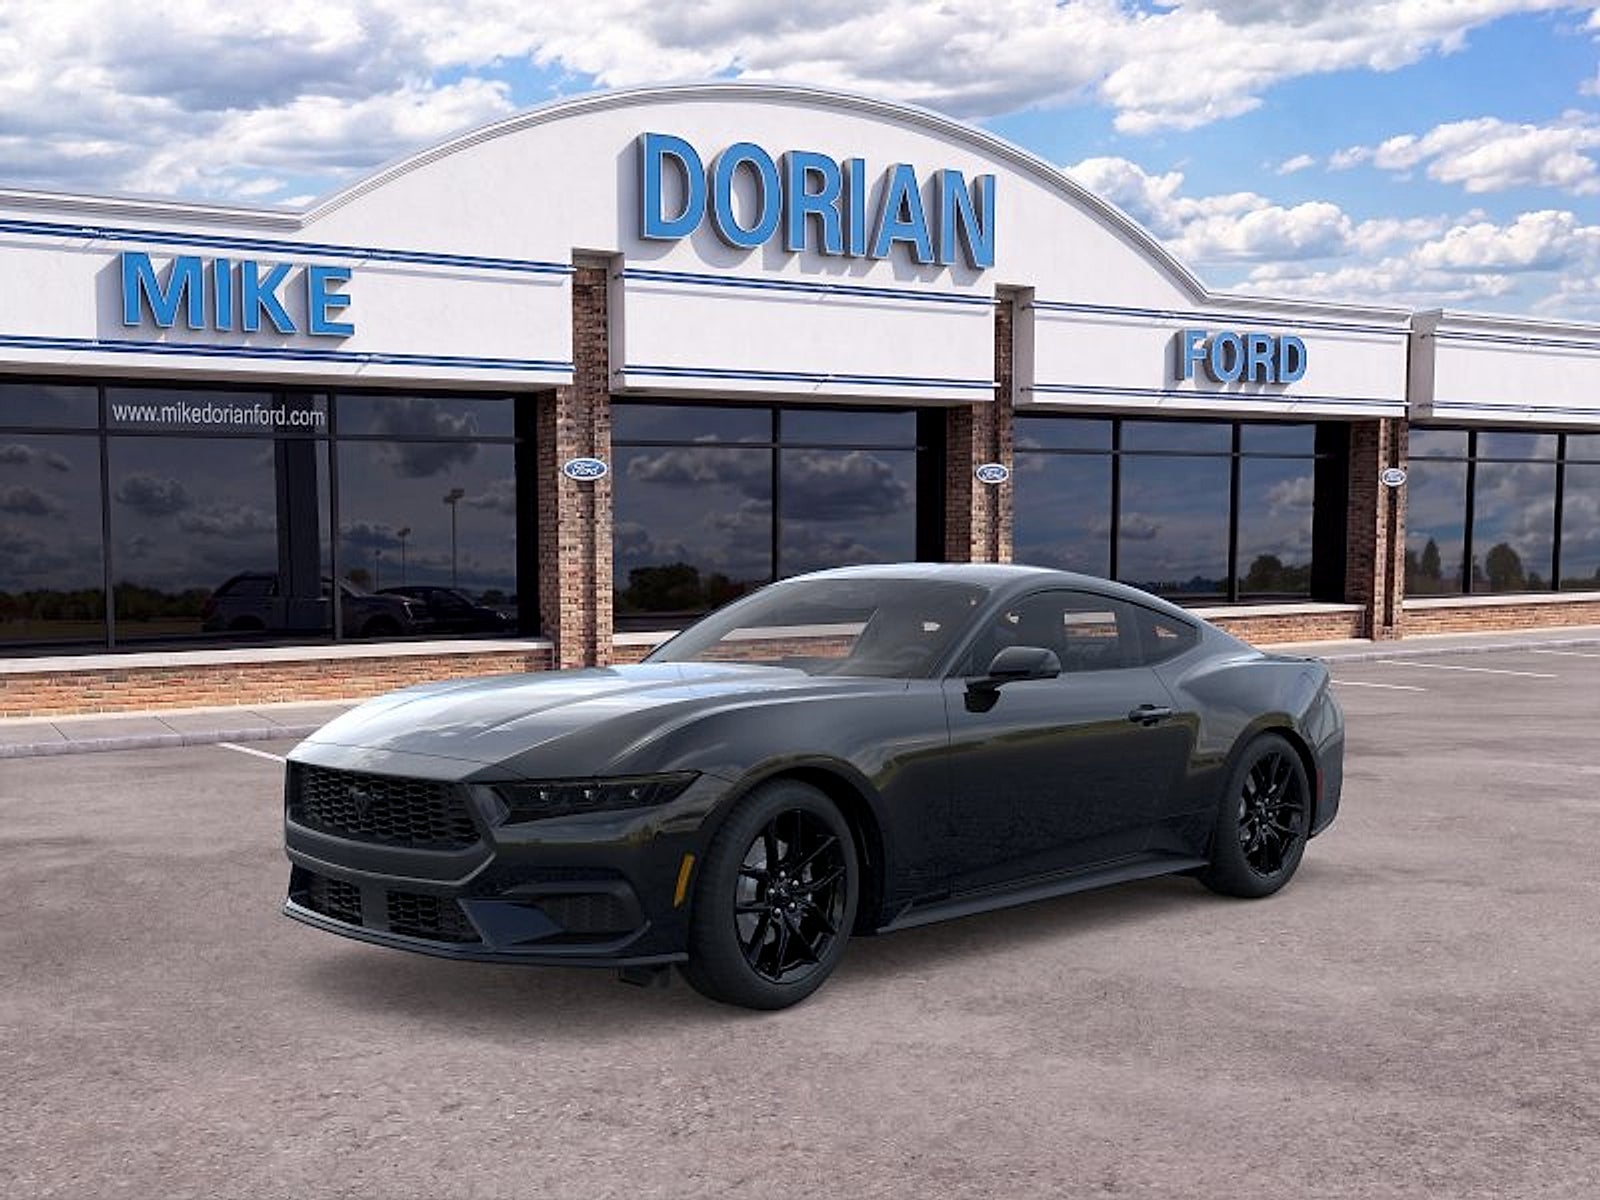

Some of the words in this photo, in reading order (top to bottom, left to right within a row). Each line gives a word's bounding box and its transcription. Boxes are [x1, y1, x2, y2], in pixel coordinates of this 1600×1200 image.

[639, 132, 995, 268] DORIAN
[121, 251, 355, 336] MIKE
[1177, 328, 1307, 384] FORD
[111, 402, 326, 427] www.mikedorianford.com
